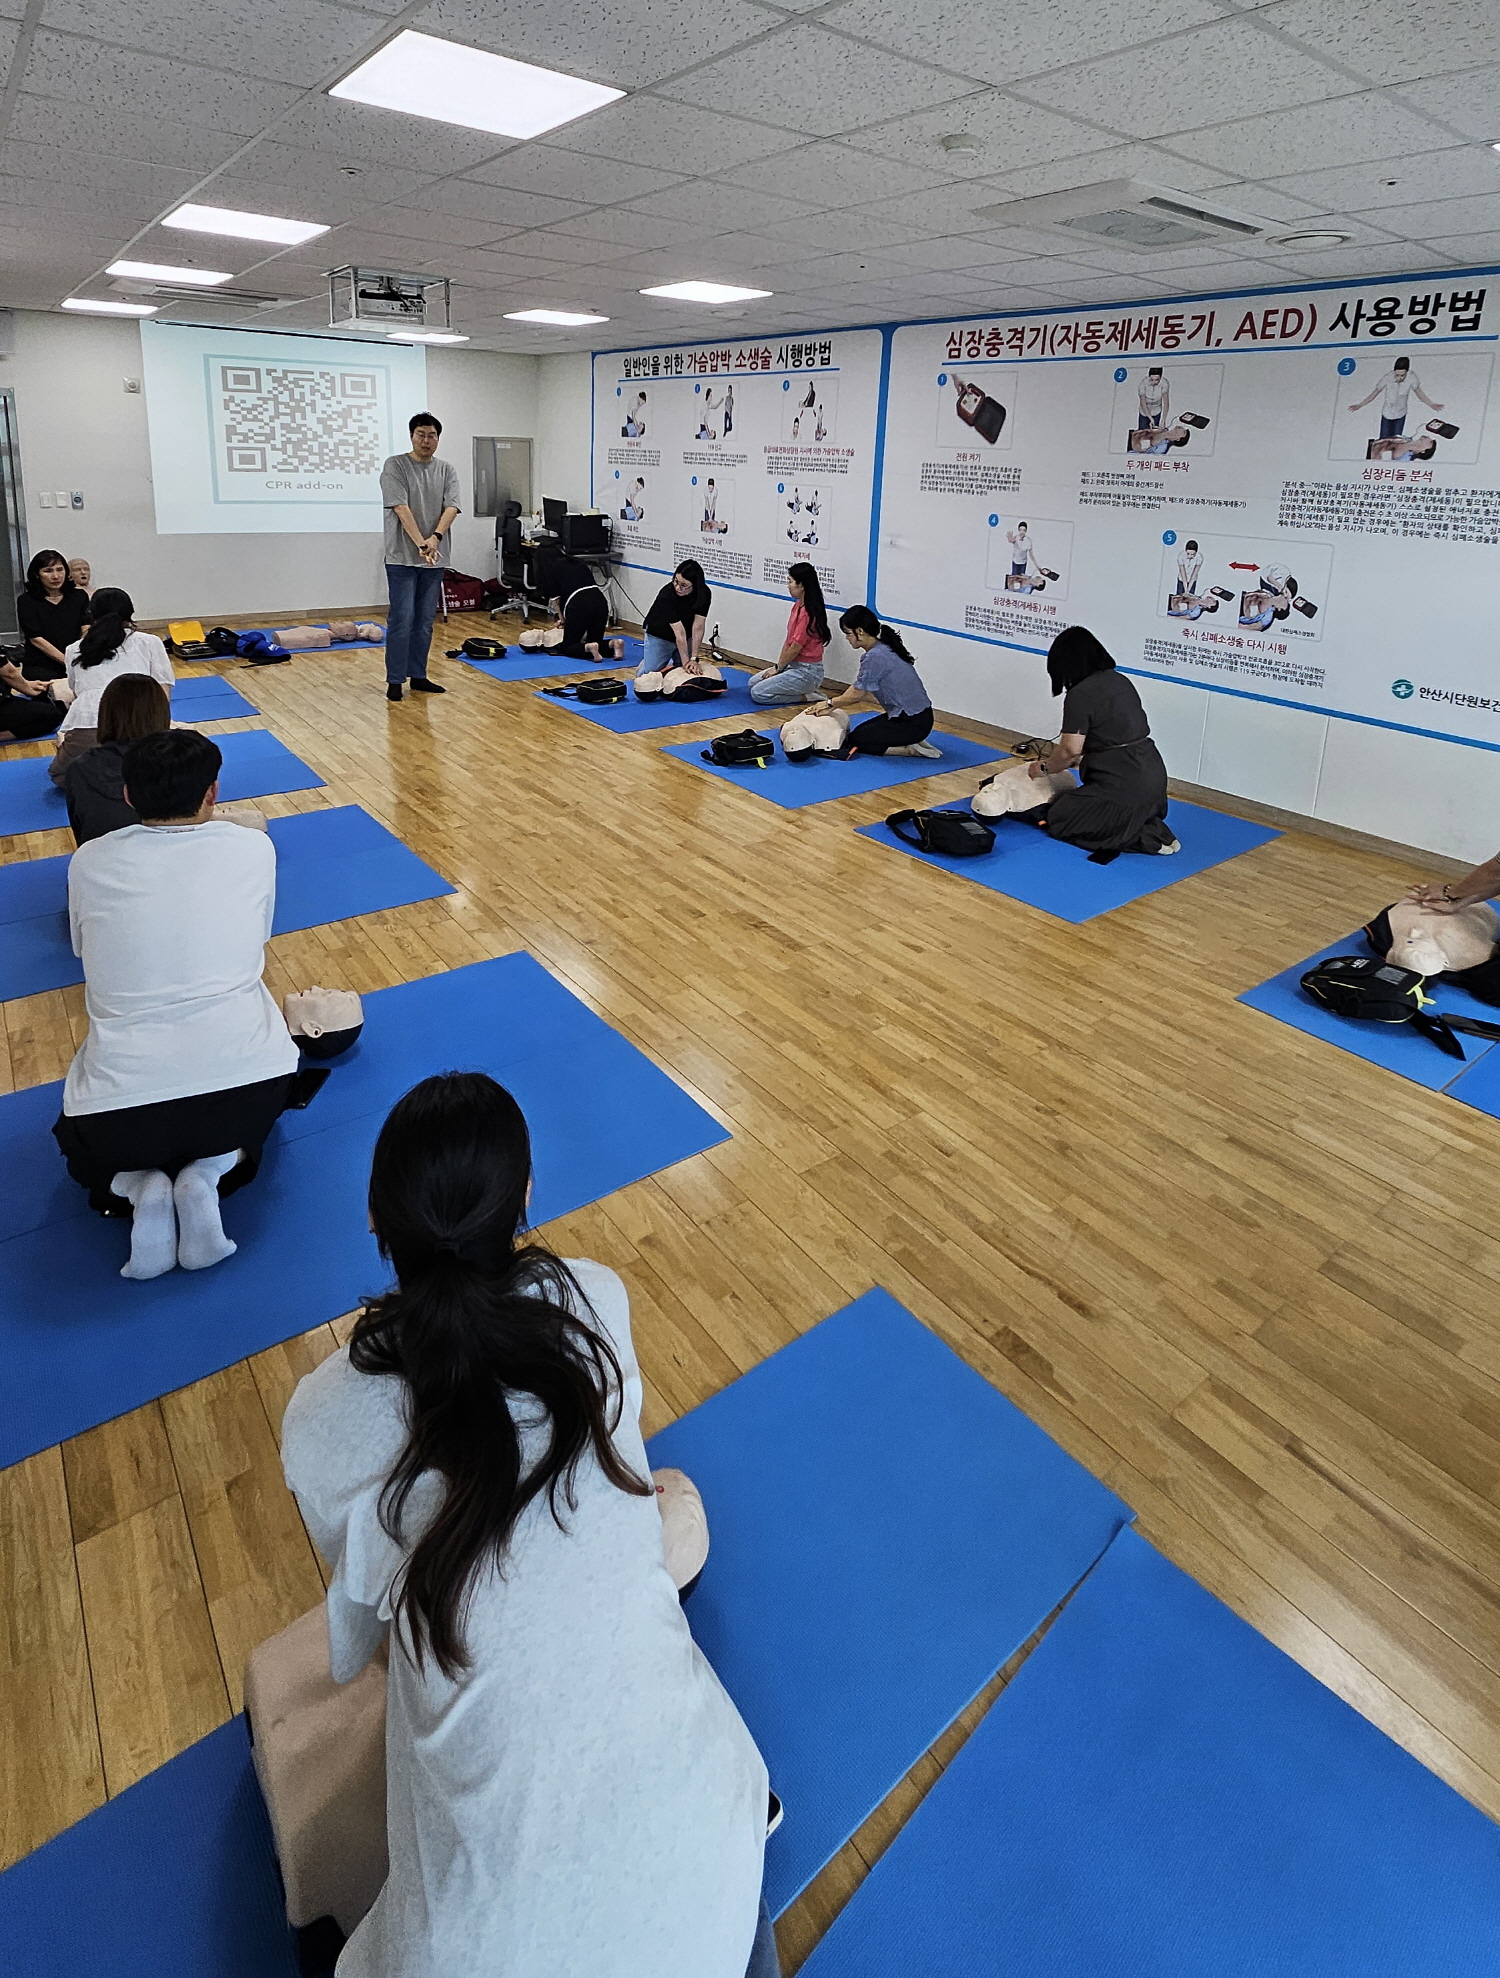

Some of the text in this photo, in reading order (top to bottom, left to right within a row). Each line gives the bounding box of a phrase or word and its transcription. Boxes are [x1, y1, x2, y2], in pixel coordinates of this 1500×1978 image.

[946, 289, 1486, 359] 심장충격기(자동제세동기, AED) 사용방법
[624, 340, 831, 377] 일반인을 위한 가슴압박 소생술 시행방법
[956, 453, 981, 462] 전원 켜기
[1127, 460, 1190, 472] 두 개의 패드 부착
[1362, 468, 1433, 482] 심장리듬 분석
[266, 481, 343, 490] CPR add-on
[1398, 486, 1442, 495] 심폐소생술을
[1445, 488, 1467, 496] 멈추고
[1281, 489, 1337, 498] 심장충격(제세동)이
[1364, 493, 1390, 501] 경우라면
[1449, 506, 1480, 515] 에너지로
[1278, 512, 1334, 522] 심장충격(제세동)이
[1427, 522, 1449, 531] 상태를
[1445, 515, 1467, 523] 가능한
[1328, 523, 1340, 531] 음성
[1402, 530, 1430, 538] 경우에는
[1451, 534, 1498, 544] 심폐소생술을
[994, 596, 1056, 615] 심장충격(제세동) 시행
[1181, 628, 1288, 655] 즉시 심폐소생술 다시 시행
